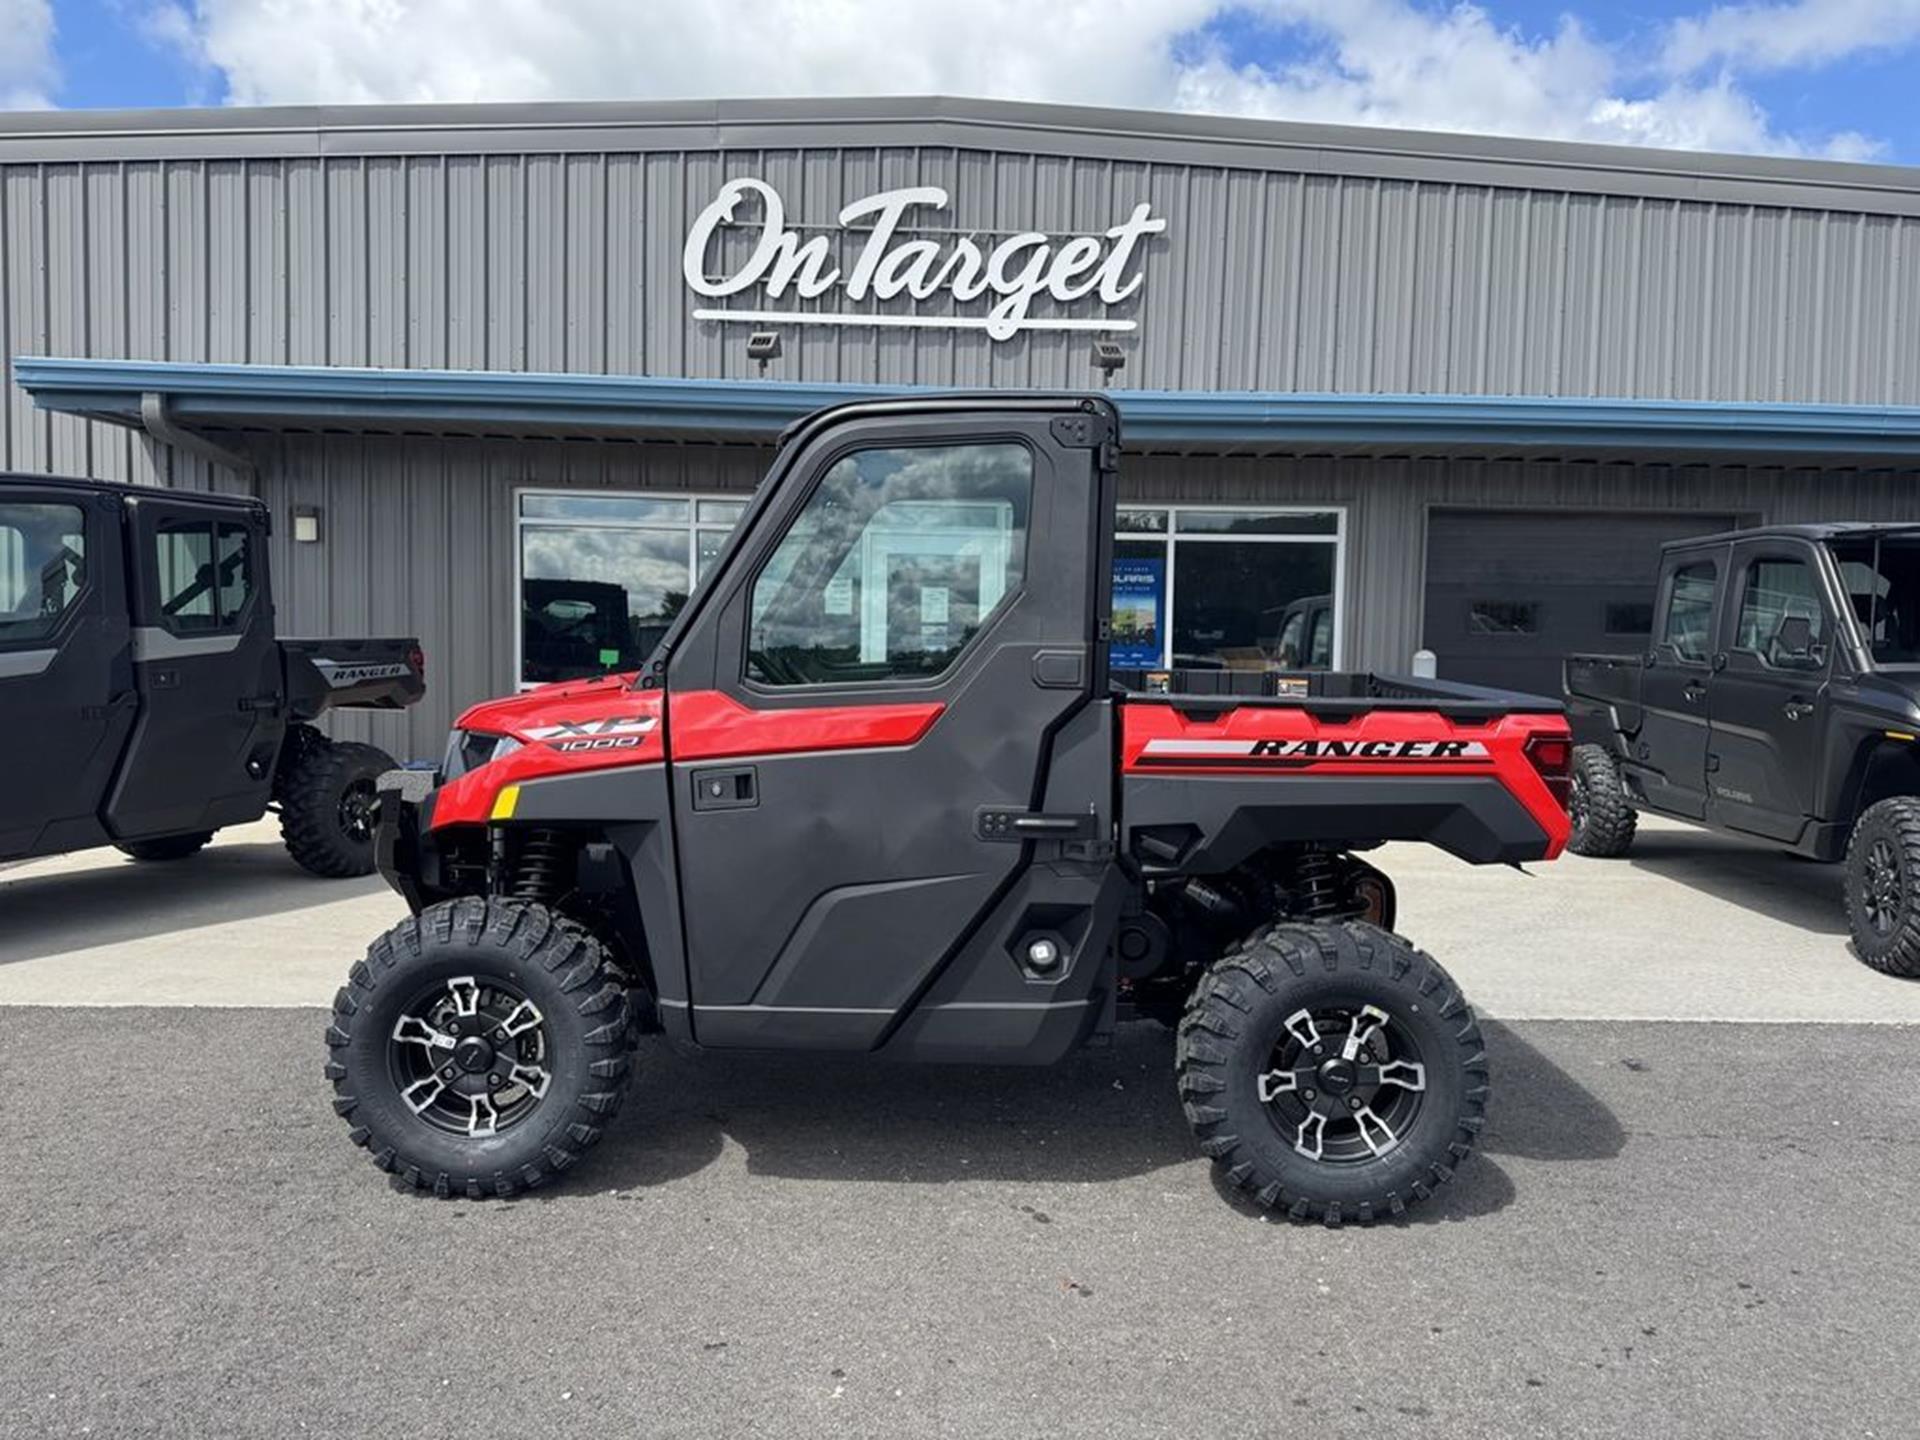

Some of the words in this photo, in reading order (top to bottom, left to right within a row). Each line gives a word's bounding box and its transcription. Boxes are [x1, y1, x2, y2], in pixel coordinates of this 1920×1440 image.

[683, 177, 840, 299] On
[838, 186, 1167, 341] Target
[333, 665, 401, 680] RANGER
[543, 715, 654, 738] XP
[560, 736, 641, 752] 1000
[1248, 739, 1469, 758] RANGER
